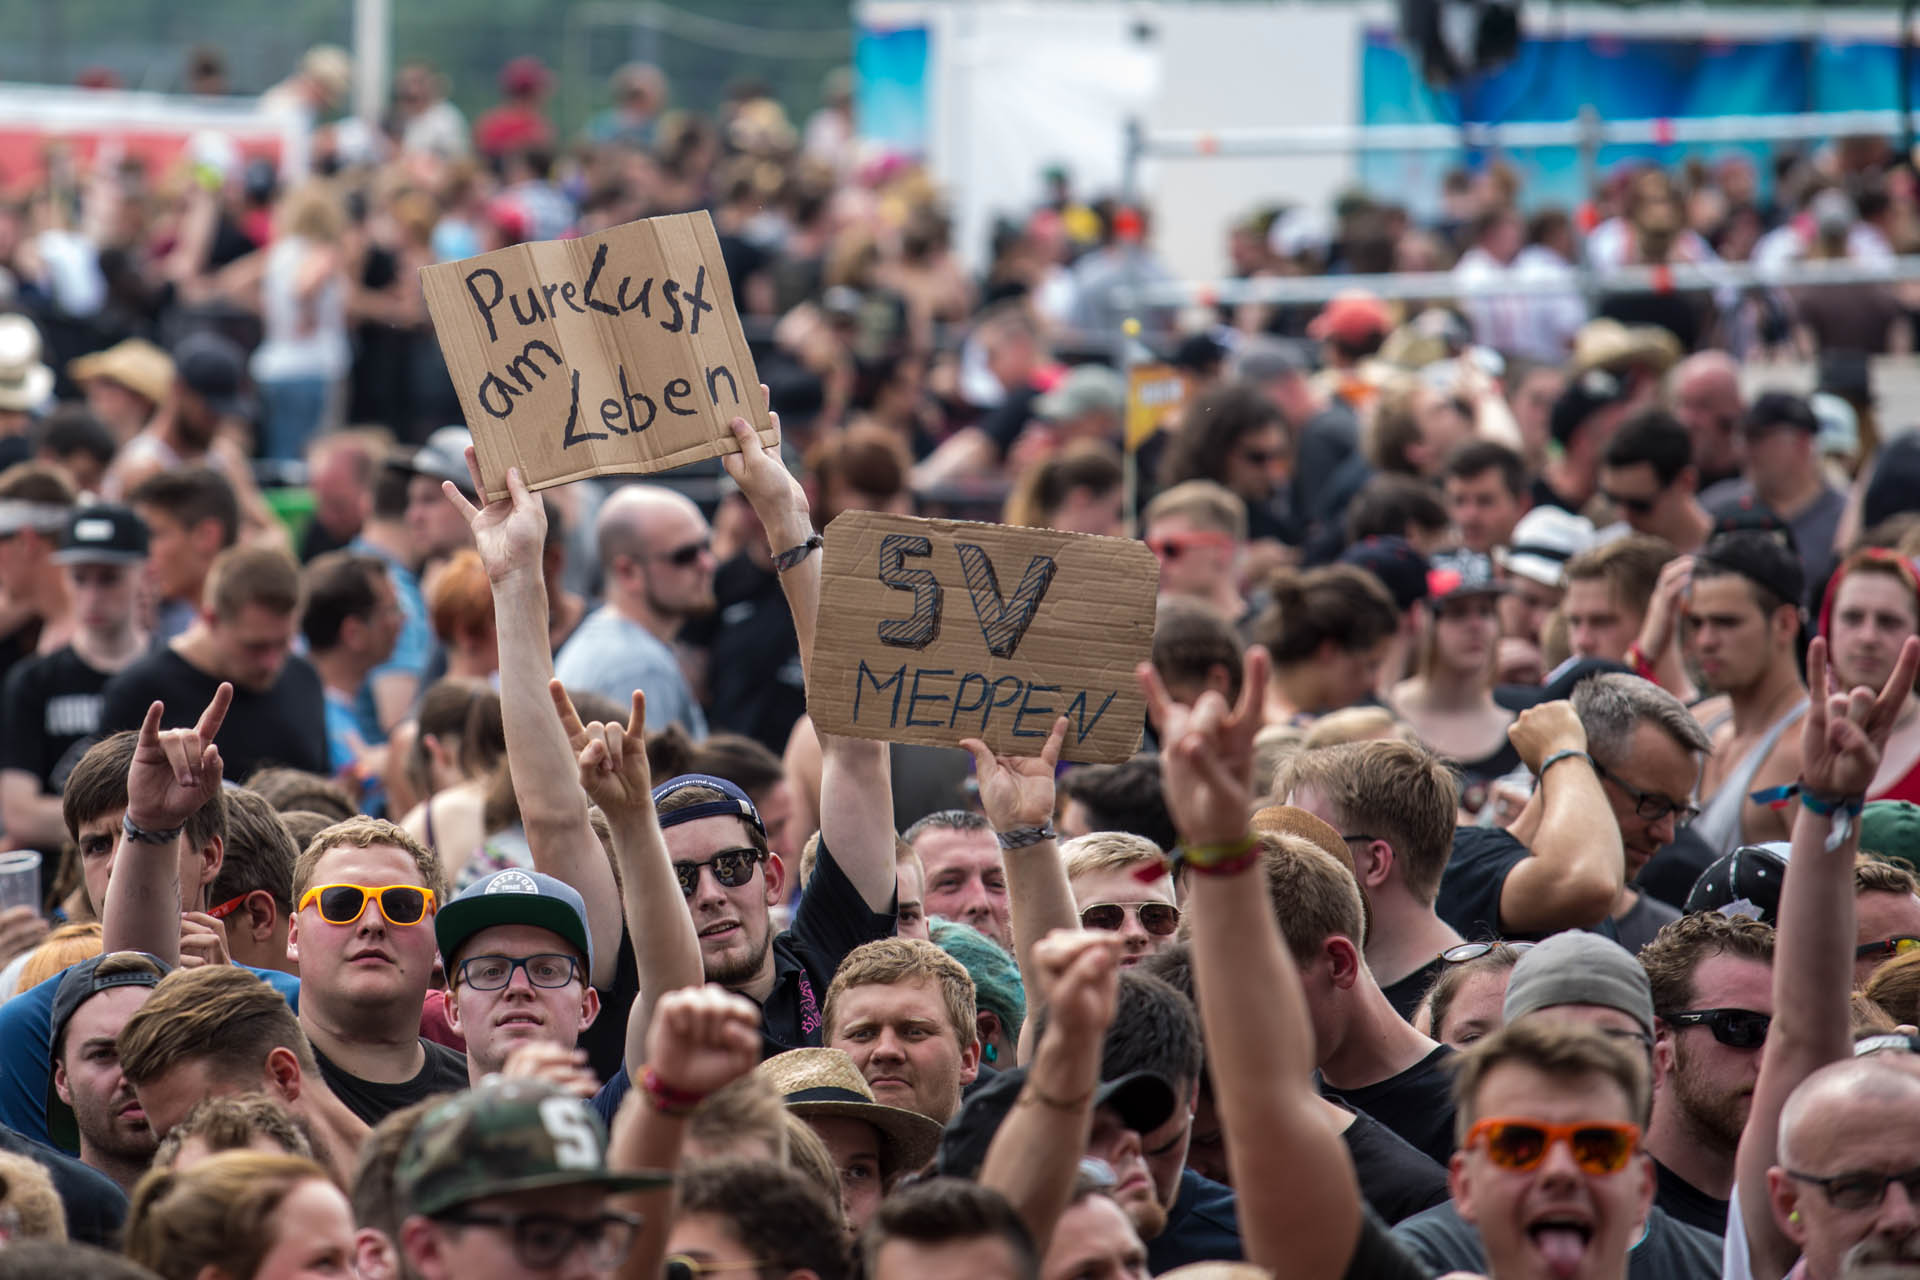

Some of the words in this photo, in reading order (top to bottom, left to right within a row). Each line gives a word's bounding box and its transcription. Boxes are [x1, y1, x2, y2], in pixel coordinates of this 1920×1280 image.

[479, 340, 563, 420] am
[563, 365, 739, 450] Leben
[878, 534, 1057, 659] SV
[854, 659, 1117, 745] MEPPEN
[540, 1096, 599, 1170] S
